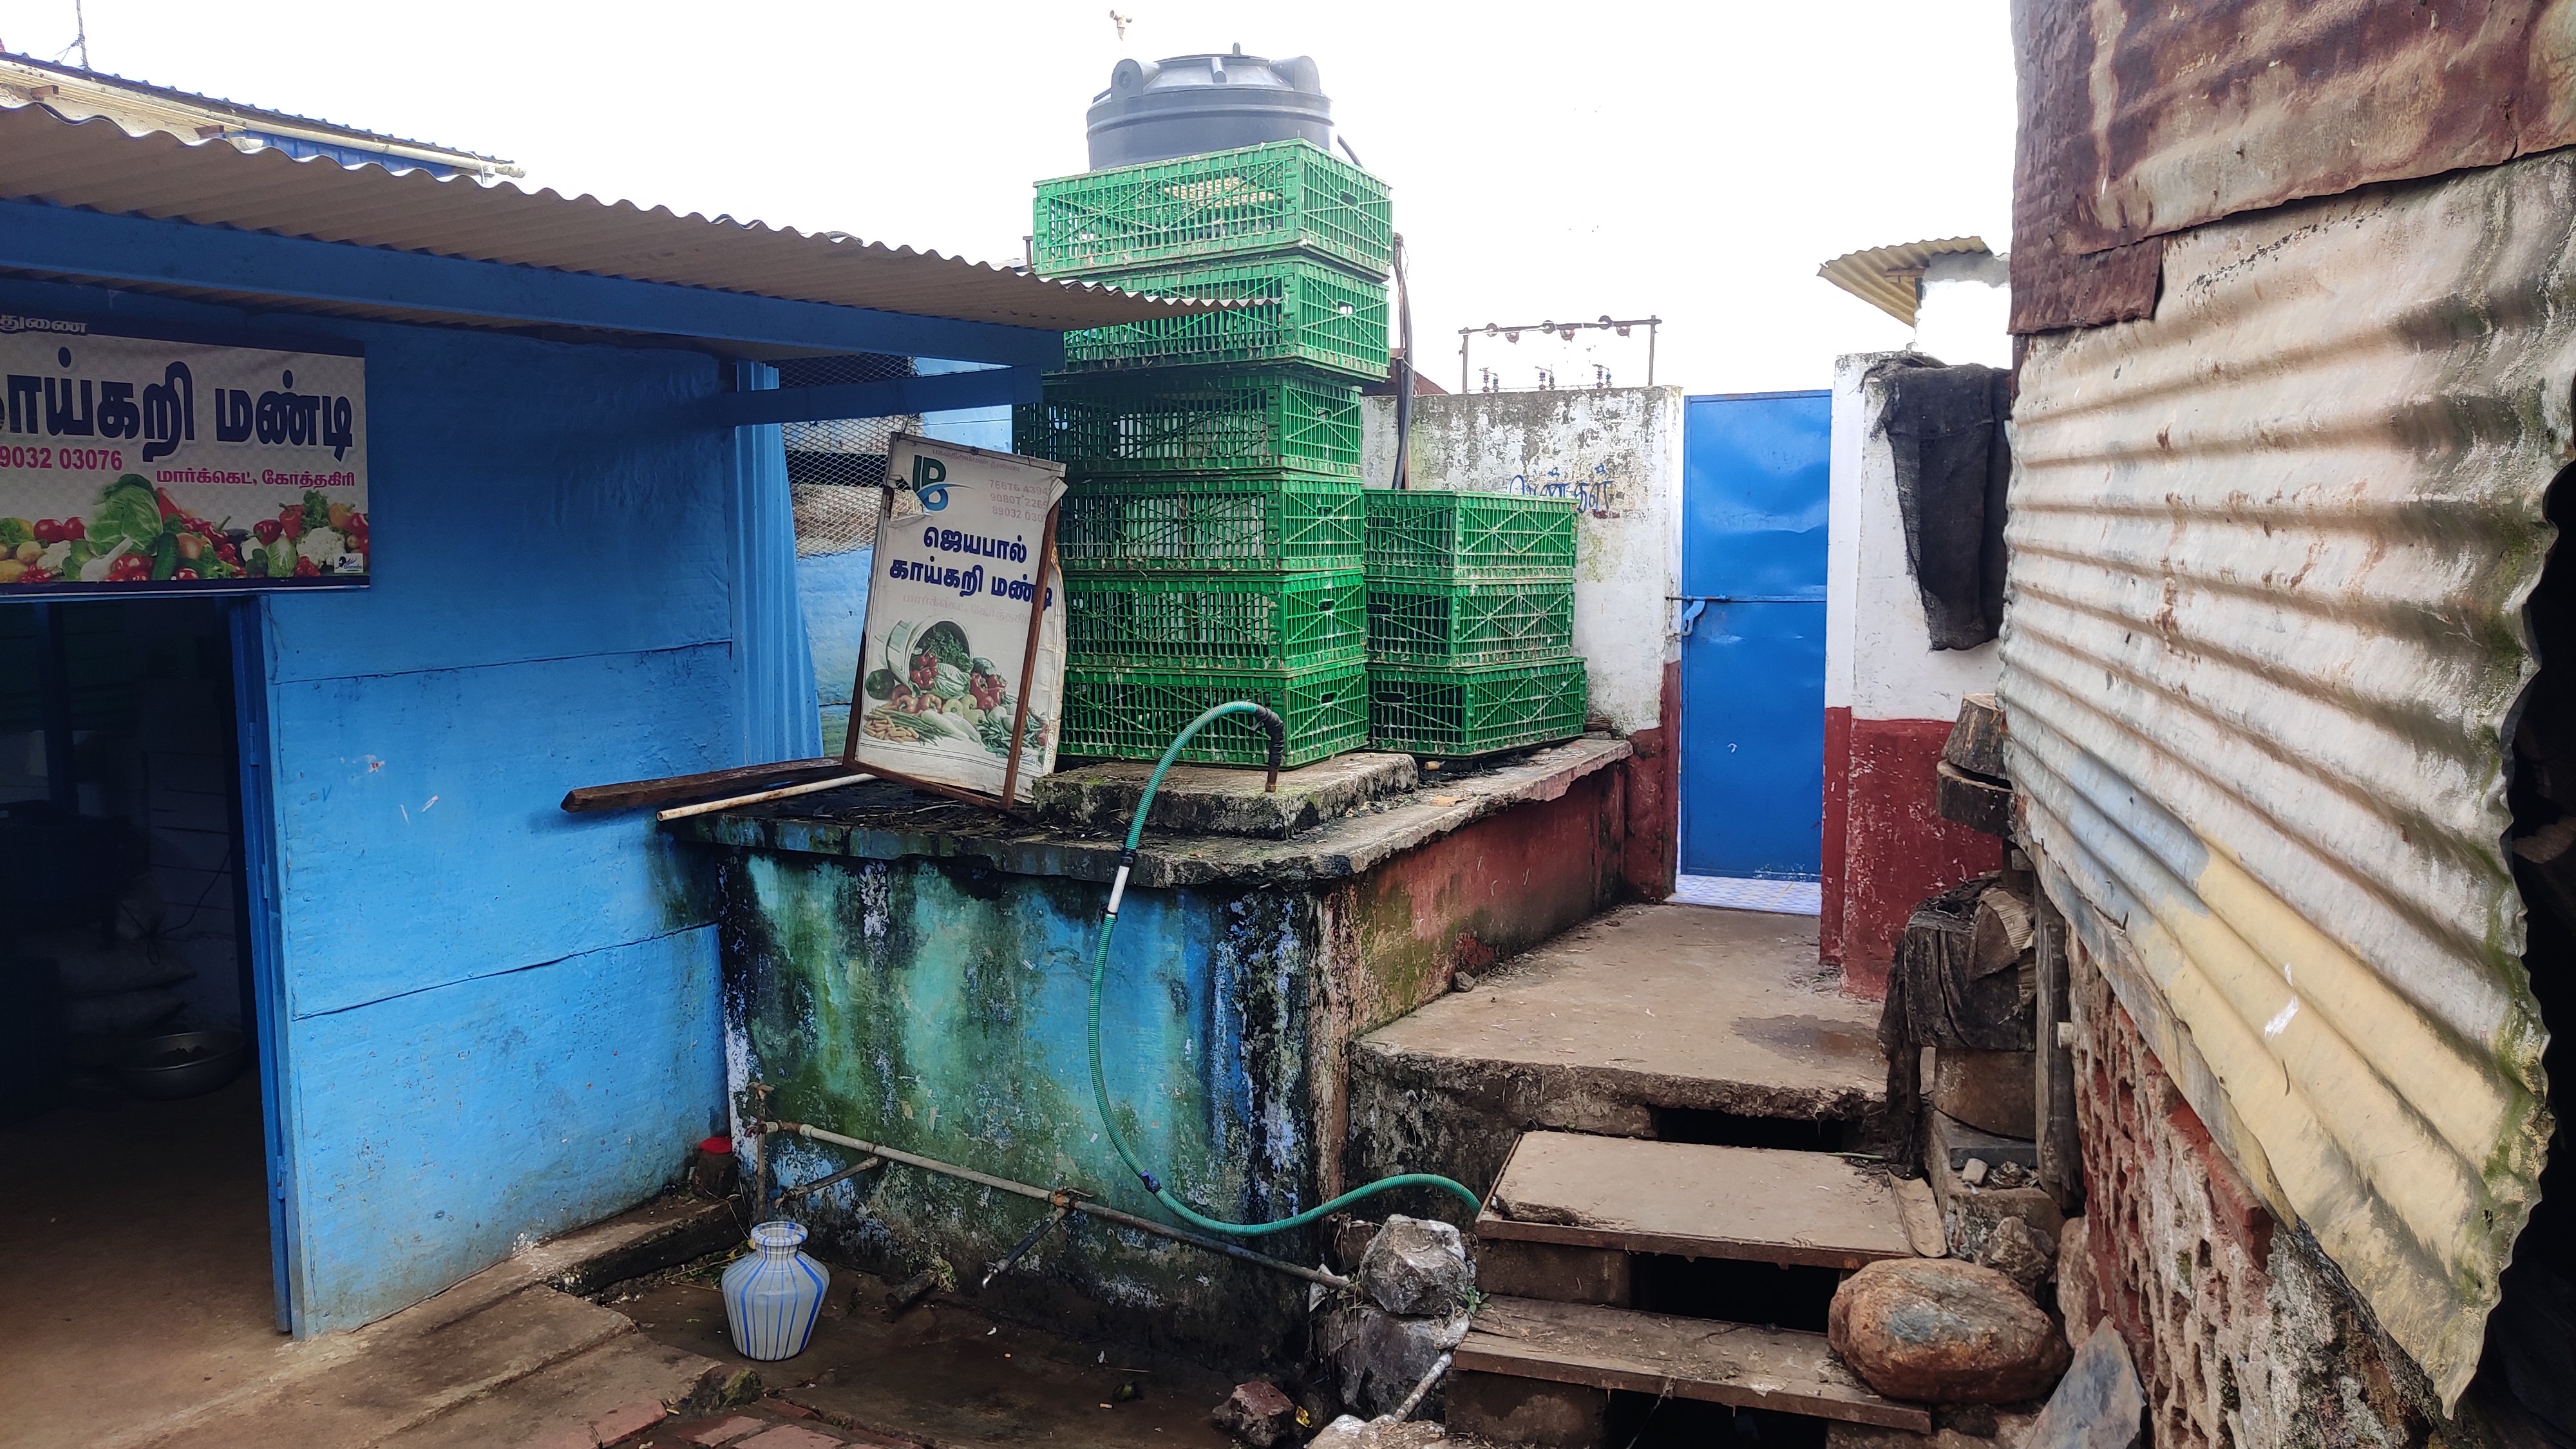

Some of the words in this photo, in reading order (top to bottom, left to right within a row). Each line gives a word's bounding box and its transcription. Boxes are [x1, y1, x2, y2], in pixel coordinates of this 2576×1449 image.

[0, 346, 195, 462] ாய்கறி
[215, 370, 353, 462] மண்டி
[59, 448, 123, 471] 03076
[261, 469, 355, 489] கோத்தகிரி
[989, 479, 1020, 492] 76676
[1023, 484, 1051, 496] 4394
[990, 493, 1021, 506] 90807
[992, 506, 1022, 518] 89032
[1025, 511, 1046, 522] 030
[923, 526, 1027, 563] ஜெயபால்
[889, 556, 984, 598] காய்கறி
[991, 574, 1053, 611] மண்ி
